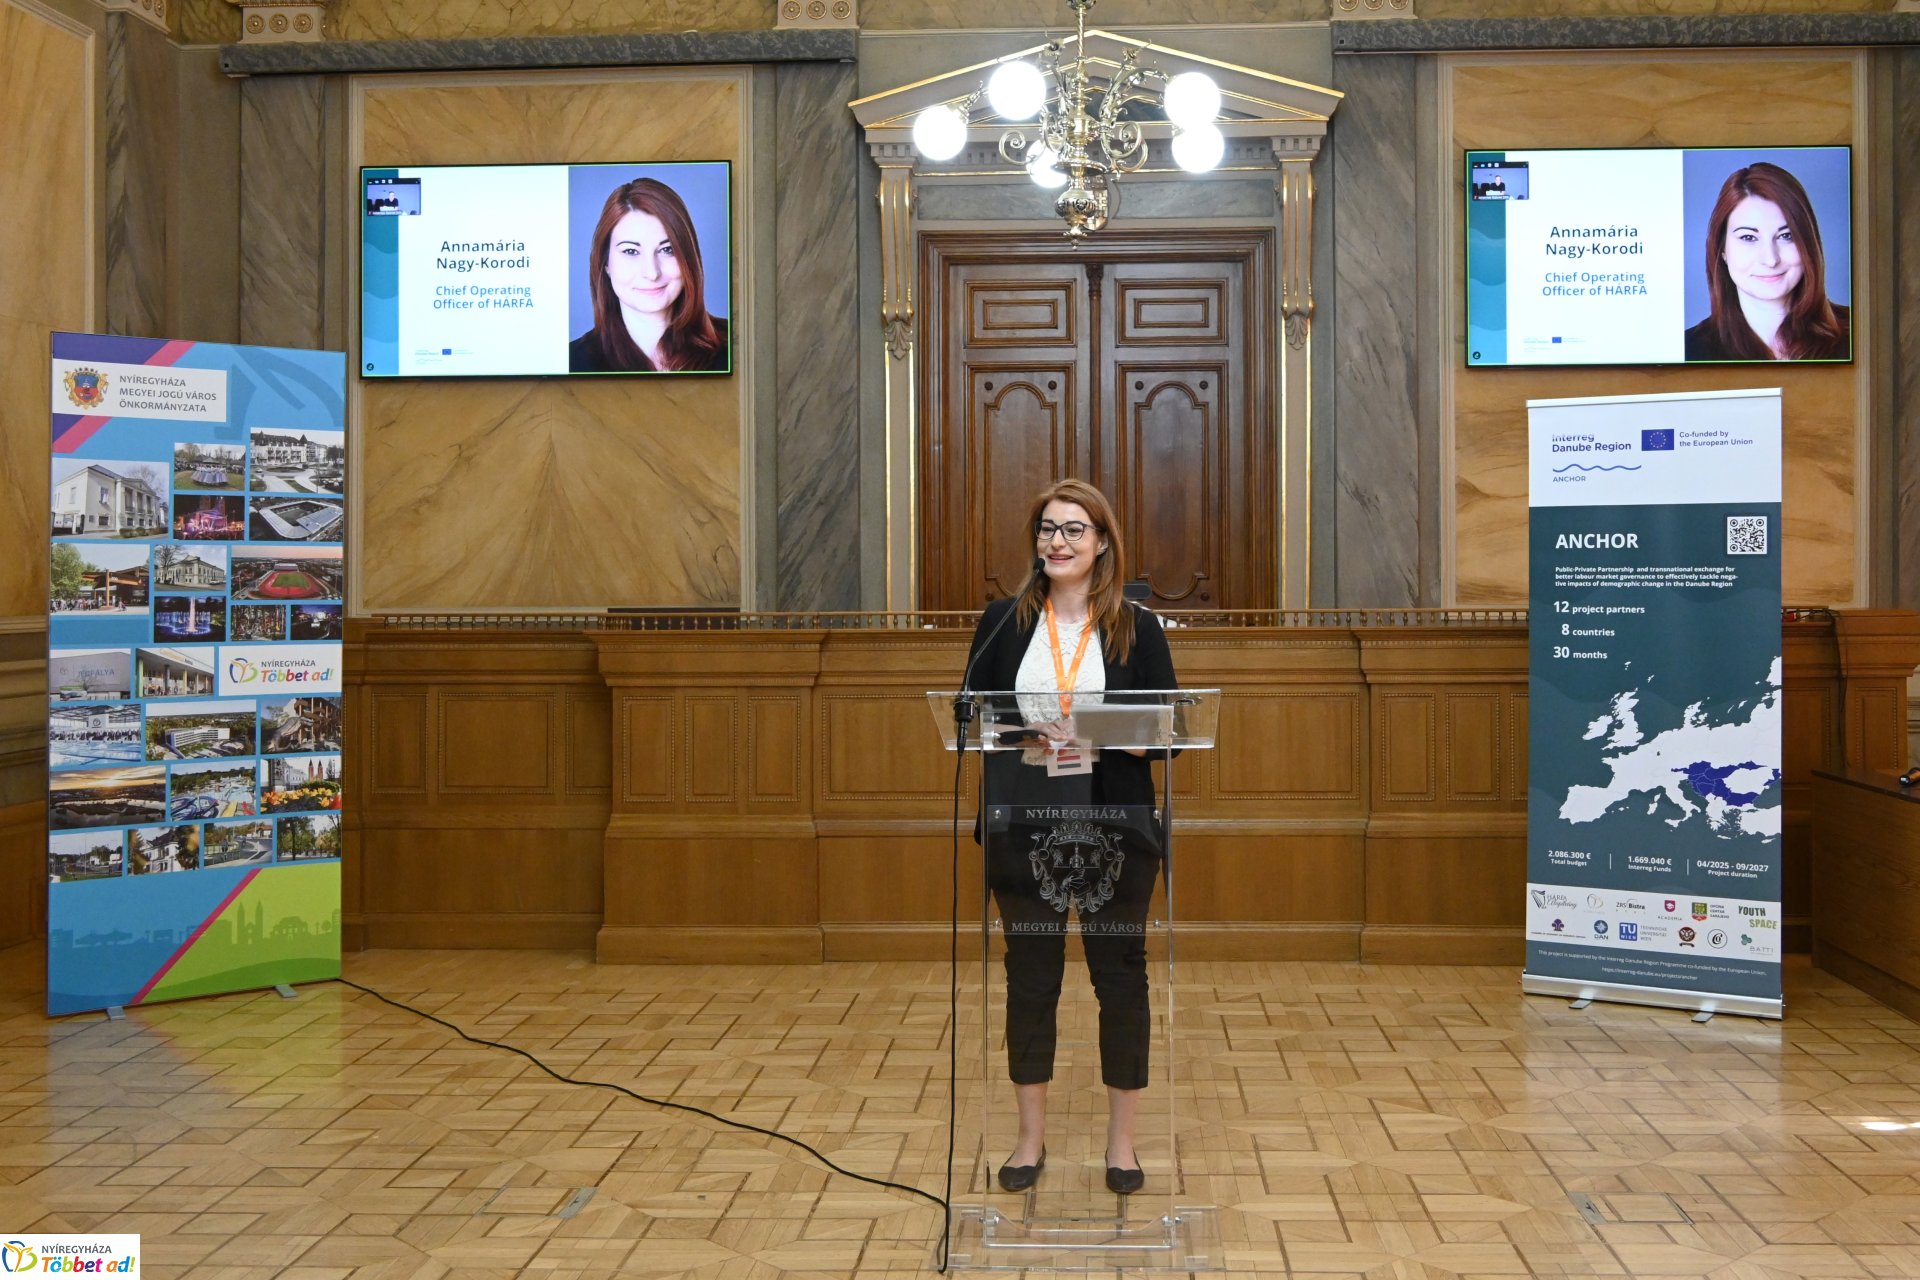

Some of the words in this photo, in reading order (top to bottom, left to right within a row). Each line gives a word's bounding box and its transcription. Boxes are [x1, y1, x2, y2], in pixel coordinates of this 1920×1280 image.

[1550, 224, 1638, 238] Annamária
[440, 238, 525, 252] Annamária
[1545, 241, 1644, 258] Nagy-Korodi
[436, 256, 530, 272] Nagy-Korodi
[1544, 270, 1577, 283] Chief
[1581, 270, 1645, 286] Operating
[436, 284, 466, 296] Chief
[470, 284, 532, 299] Operating
[1542, 284, 1585, 296] Officer
[1589, 284, 1602, 296] of
[1605, 282, 1648, 296] HÁRFA
[433, 298, 474, 310] Officer
[478, 298, 490, 309] of
[493, 296, 534, 308] HÁRFA
[119, 374, 187, 388] NYÍREGYHÁZA
[119, 388, 156, 398] MEGYEI
[158, 388, 184, 400] JOGÚ
[186, 388, 217, 401] VÁROS
[119, 398, 207, 413] ÖNKORMÁNYZATA
[1679, 430, 1718, 438] Co-funded
[1720, 430, 1729, 438] by
[1552, 444, 1592, 452] Danube
[1594, 442, 1632, 452] Region
[1693, 440, 1729, 448] European
[1730, 438, 1753, 446] Union
[1555, 533, 1639, 549] ANCHOR
[1598, 566, 1634, 574] Partnership
[1665, 574, 1699, 582] effectively
[1720, 574, 1739, 582] nega-
[1553, 601, 1570, 613] 12
[1572, 606, 1604, 614] project
[1606, 606, 1646, 614] partners
[1561, 624, 1570, 636] 8
[1572, 628, 1616, 636] countries
[1553, 646, 1570, 659] 30
[1573, 651, 1608, 659] months
[261, 658, 316, 668] NYÍREGYHÁZA
[261, 669, 310, 683] Többet
[312, 668, 335, 682] ad!
[1026, 806, 1128, 820] NYÍREGYHÁZA
[1548, 850, 1585, 859] 2.086.300
[1586, 852, 1592, 860] €
[1628, 856, 1665, 865] 1.669.040
[1666, 858, 1672, 866] €
[1628, 864, 1652, 872] Interreg
[1696, 860, 1730, 870] 04/2025
[1736, 862, 1769, 872] 09/2027
[1708, 869, 1730, 877] Project
[1628, 902, 1646, 910] Bistra
[1738, 905, 1766, 917] YOUTH
[1011, 922, 1060, 932] MEGYEI
[1063, 920, 1098, 932] JGÚ
[1100, 920, 1143, 933] VÁROS
[1620, 924, 1636, 934] TU
[1748, 919, 1778, 930] SPACE
